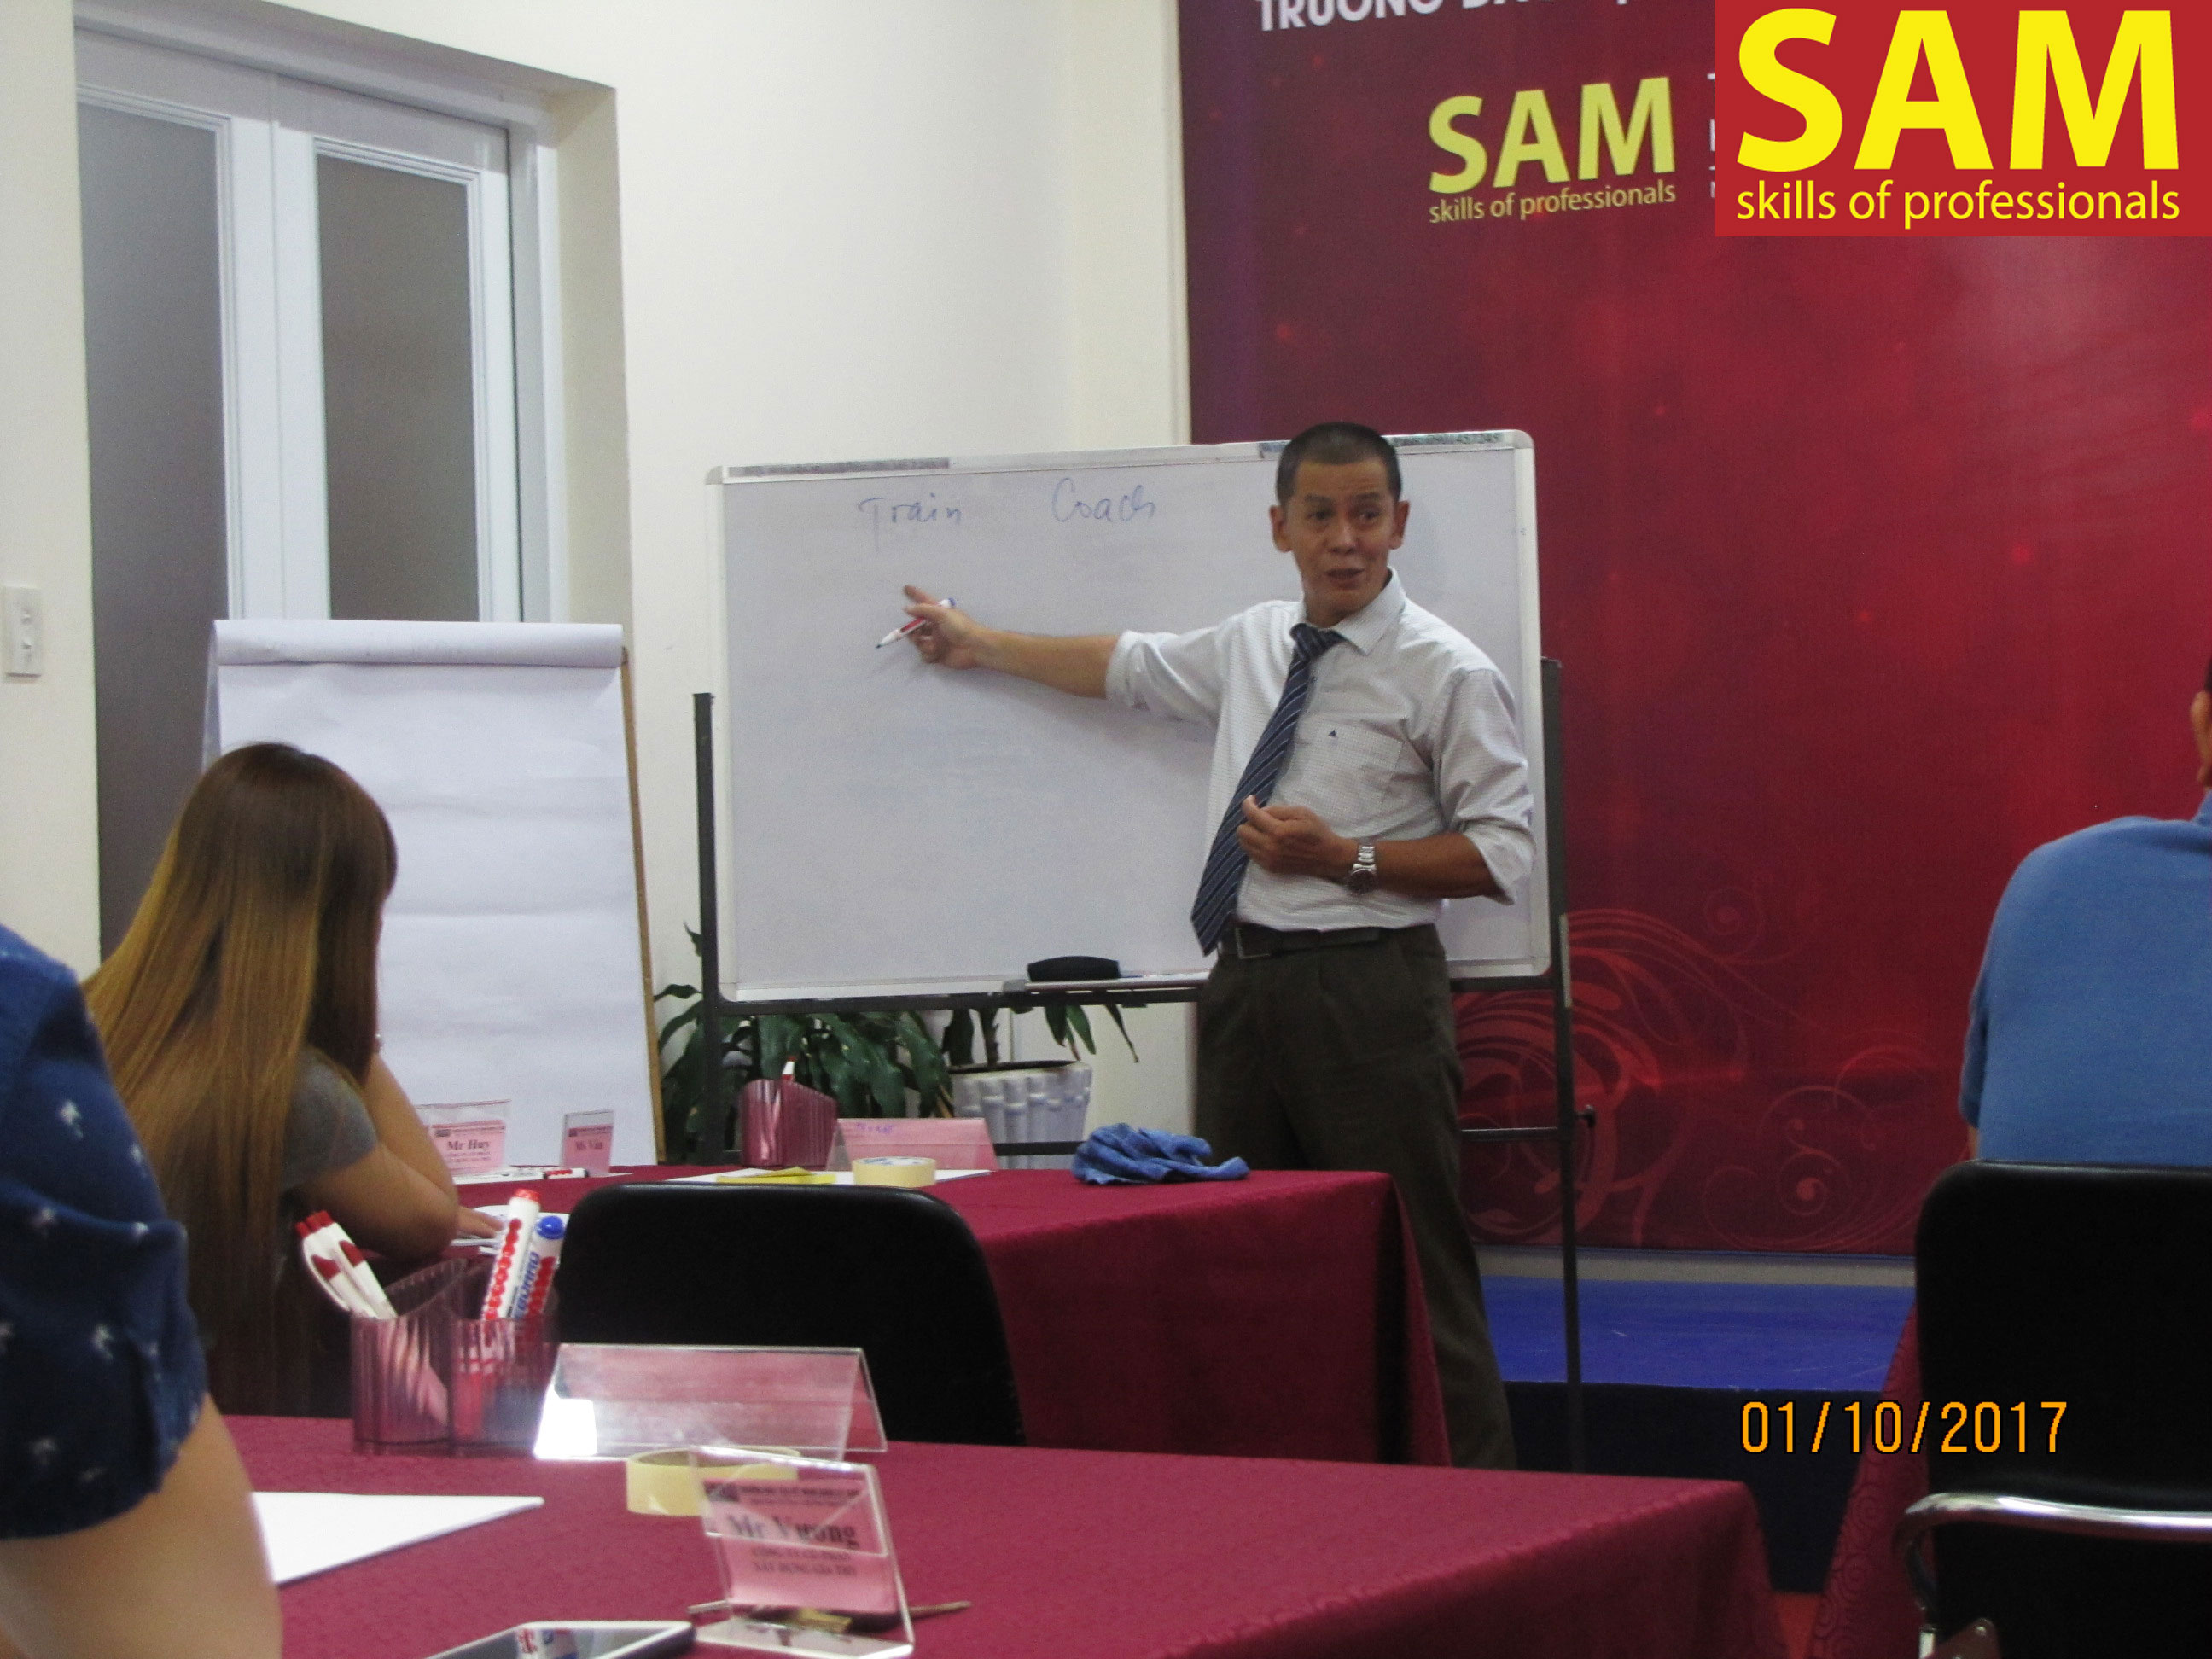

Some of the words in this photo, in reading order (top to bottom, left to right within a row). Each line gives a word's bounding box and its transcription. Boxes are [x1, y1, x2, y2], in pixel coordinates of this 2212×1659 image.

[1429, 77, 1675, 194] SAM
[1429, 196, 1483, 224] skills
[1489, 192, 1516, 217] of
[1520, 179, 1676, 220] professionals
[858, 492, 962, 551] Train
[1052, 477, 1156, 522] Coach
[448, 1141, 465, 1151] Mr
